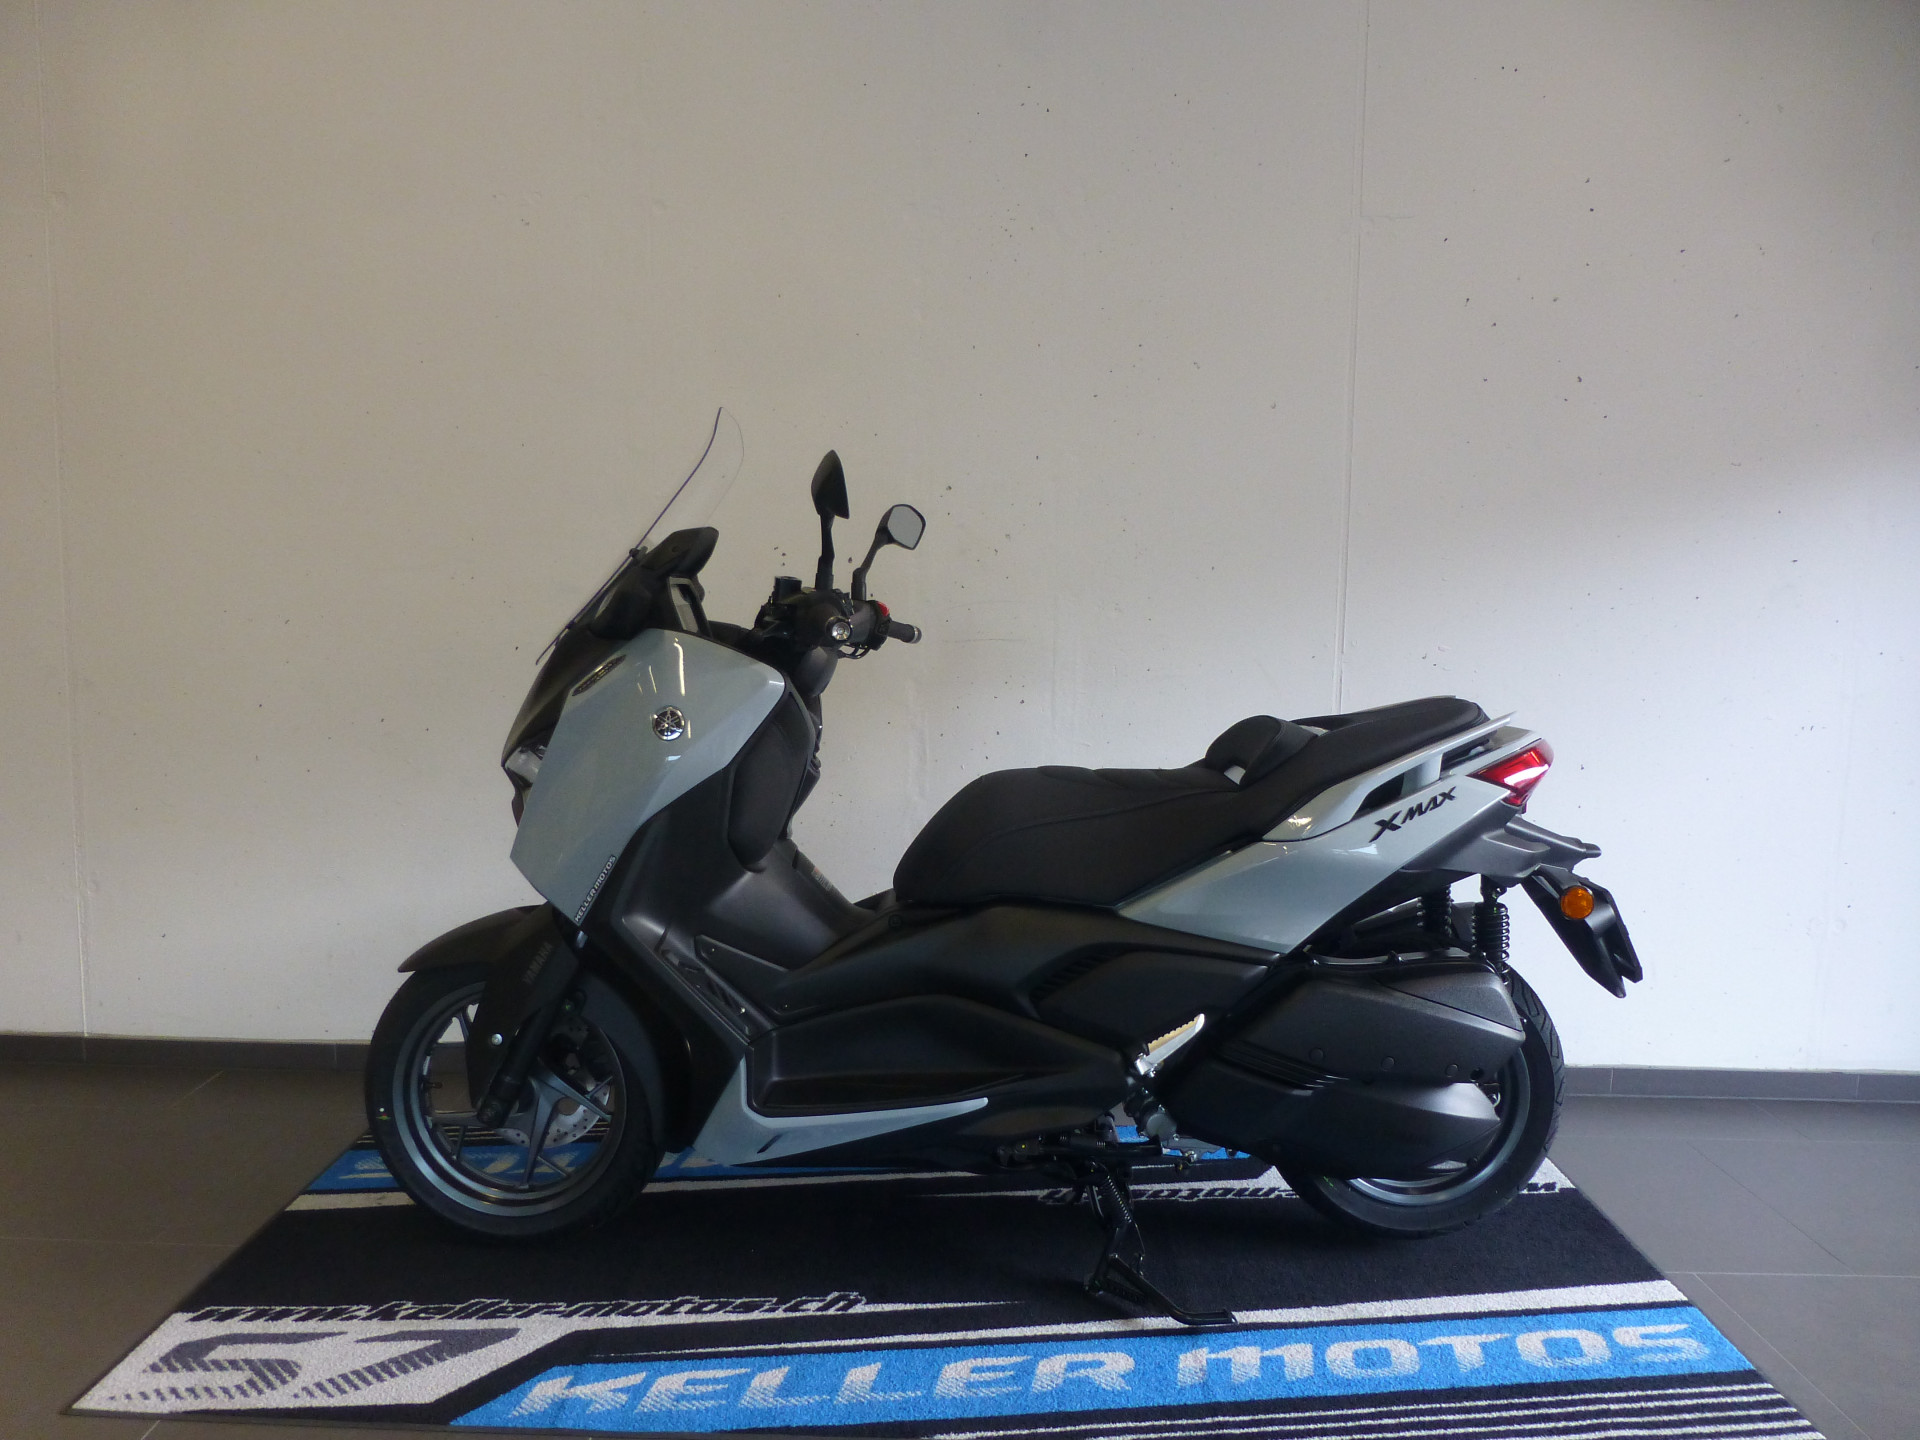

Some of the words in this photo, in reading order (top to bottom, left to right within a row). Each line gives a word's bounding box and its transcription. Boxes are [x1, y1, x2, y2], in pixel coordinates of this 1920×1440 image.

[521, 942, 553, 984] YAMAHA
[508, 1351, 1135, 1418] KELLER
[1176, 1323, 1711, 1388] MOTOS
